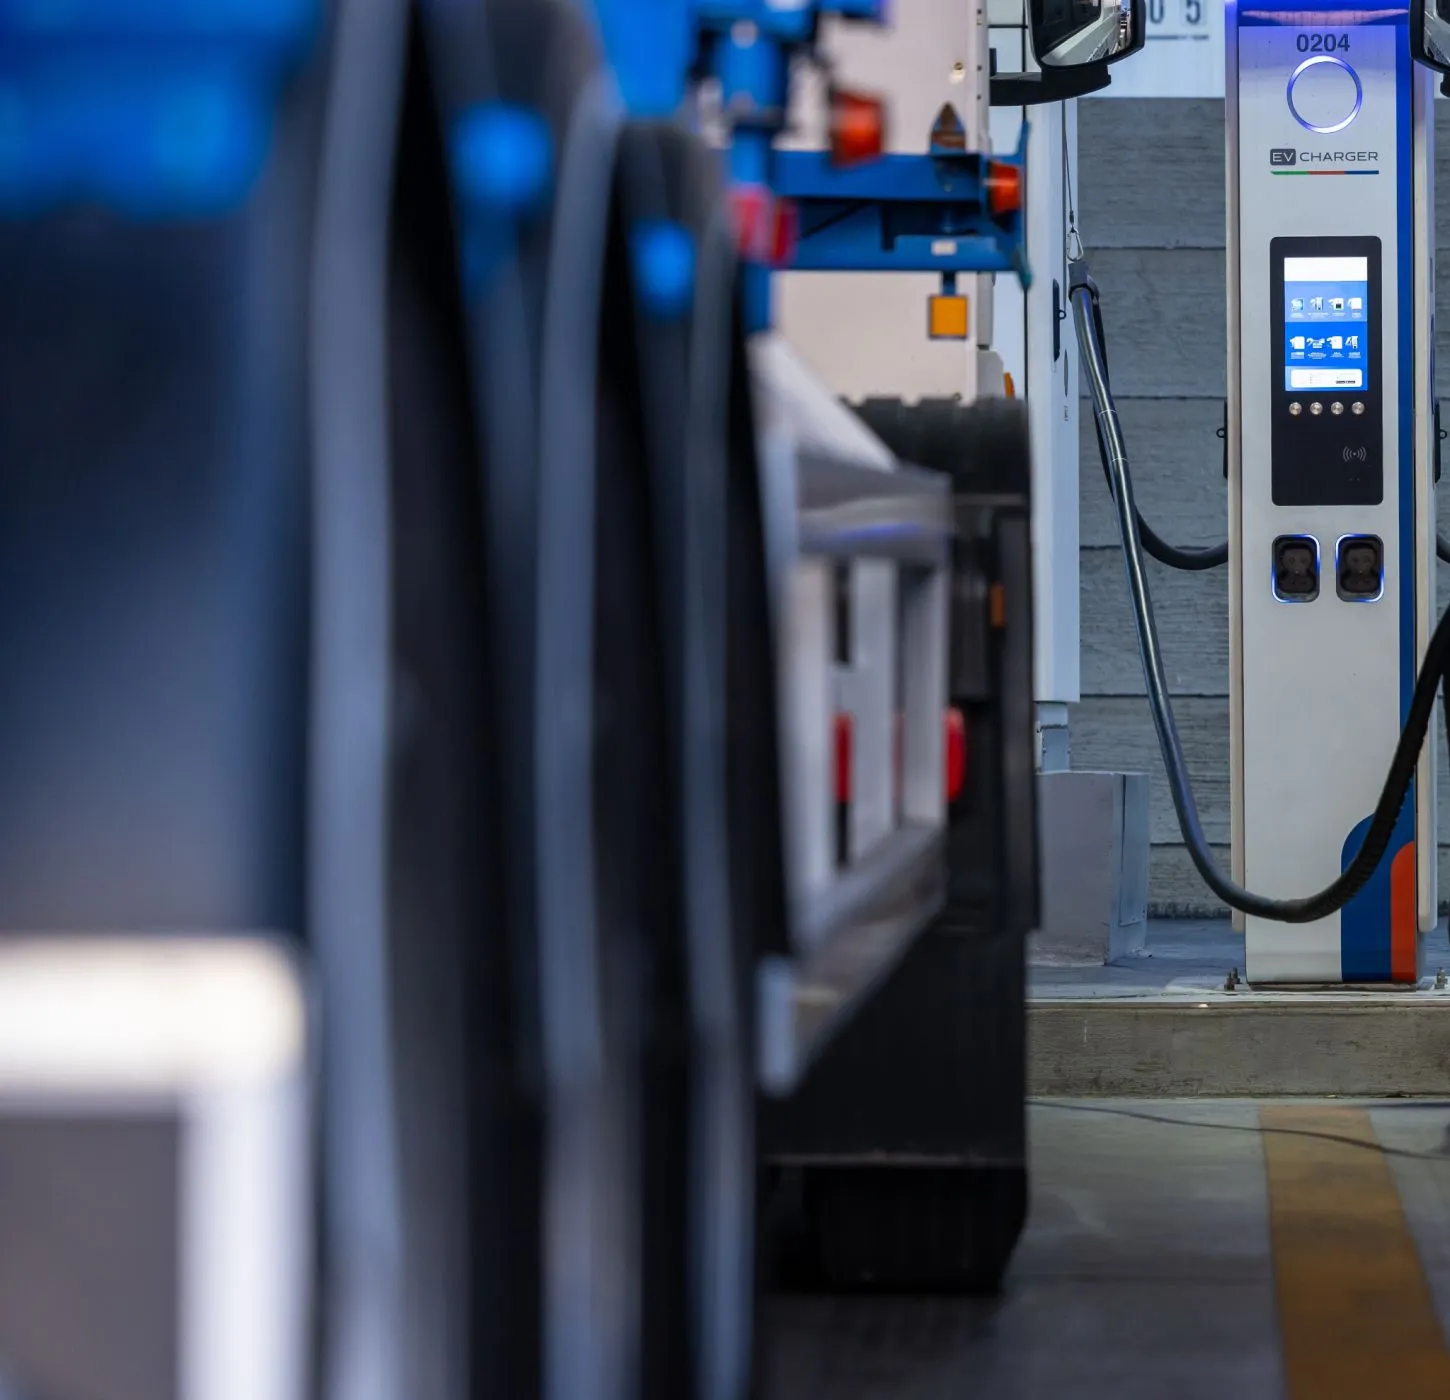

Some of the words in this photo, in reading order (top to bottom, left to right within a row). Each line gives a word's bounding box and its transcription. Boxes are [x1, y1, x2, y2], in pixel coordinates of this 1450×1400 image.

[1296, 33, 1350, 53] 0204
[1272, 151, 1295, 163] EV
[1299, 151, 1379, 162] CHARGER
